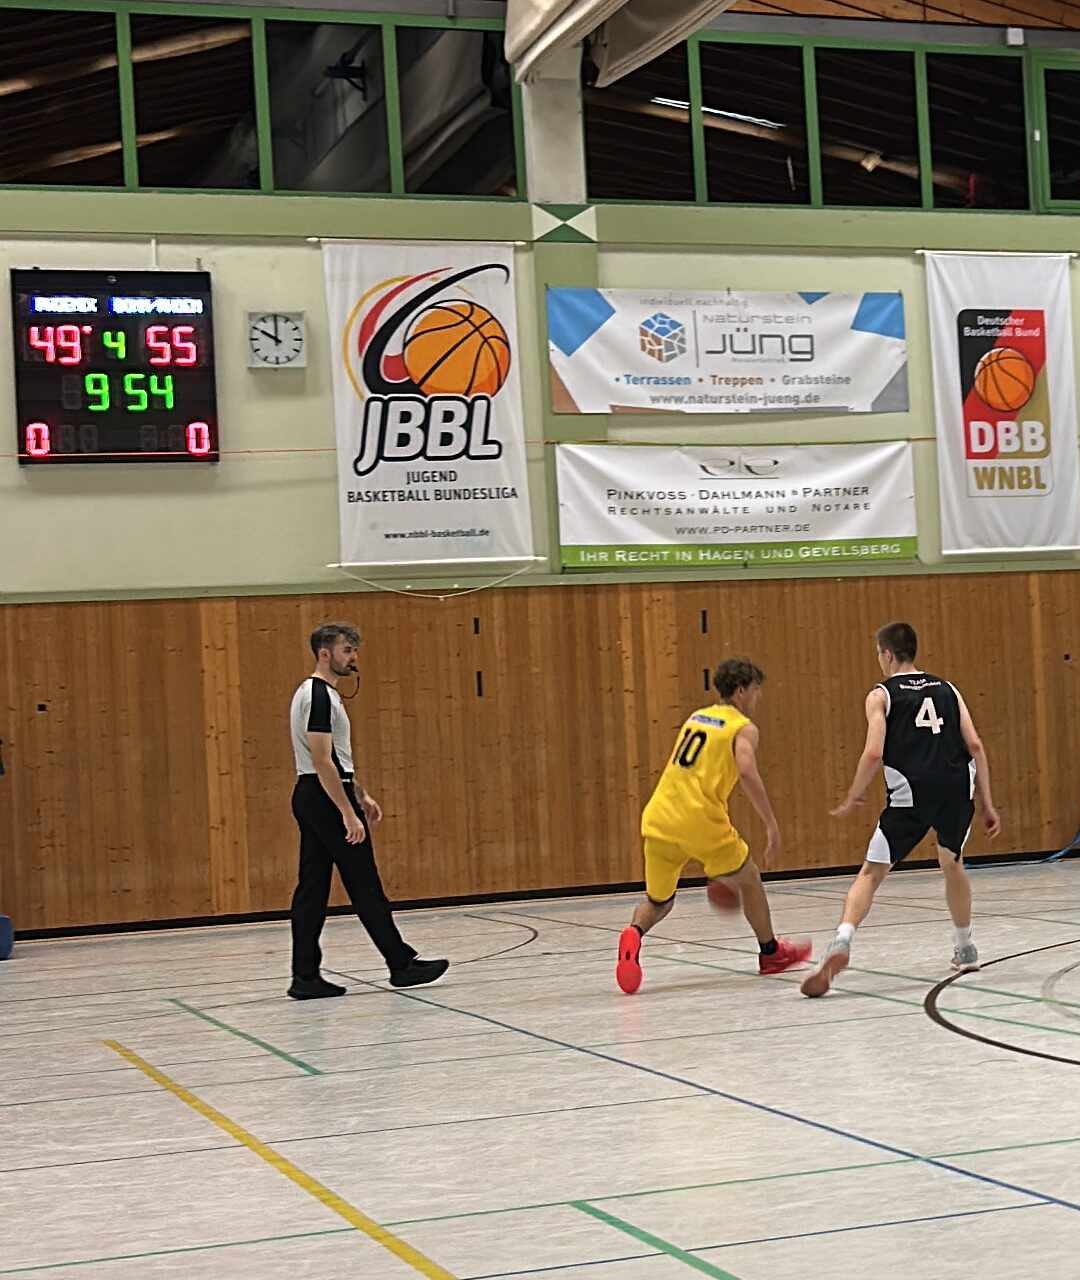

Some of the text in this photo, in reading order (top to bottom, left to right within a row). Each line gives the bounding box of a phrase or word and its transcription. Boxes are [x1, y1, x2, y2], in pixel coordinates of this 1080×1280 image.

[977, 315, 1025, 326] Deutscher
[963, 326, 1041, 337] Basketball Bund
[30, 325, 197, 365] 49 4 55
[623, 374, 851, 387] Terrassen Treppen Grabsteine
[649, 392, 821, 406] www.naturstein-jueng.de
[26, 422, 210, 457] 0 0
[354, 395, 502, 476] JBBL
[969, 421, 1046, 453] DBB
[406, 471, 458, 485] JUGEND
[973, 466, 1046, 490] WNBL
[347, 487, 518, 503] BASKETBALL BUNDESLIGA
[607, 489, 687, 500] PINKVOSS
[699, 489, 786, 500] DAHLMANN
[802, 486, 870, 498] PARTNER
[607, 503, 871, 516] RECHTSANWÄLTE UND NOTARE
[580, 543, 901, 562] IHR RECHT IN HAGEN UND GEVELSBERG
[915, 696, 944, 734] 4
[673, 728, 707, 767] 10
